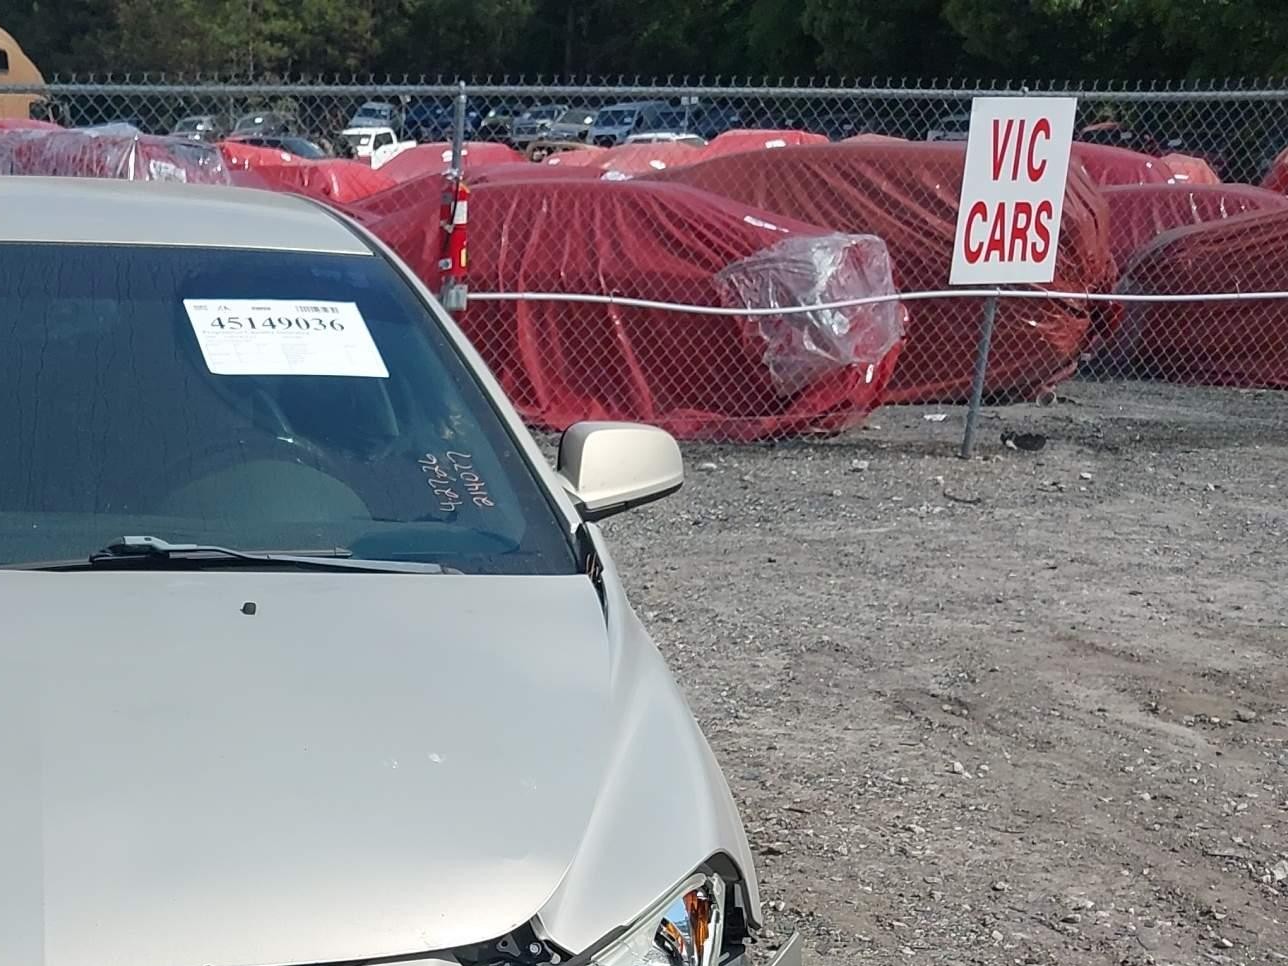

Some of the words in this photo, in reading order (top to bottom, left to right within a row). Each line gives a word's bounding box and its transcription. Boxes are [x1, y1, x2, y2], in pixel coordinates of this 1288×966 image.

[992, 118, 1051, 182] VIC
[963, 200, 1053, 264] CARS
[210, 316, 345, 332] 45149036
[446, 451, 495, 508] 214077
